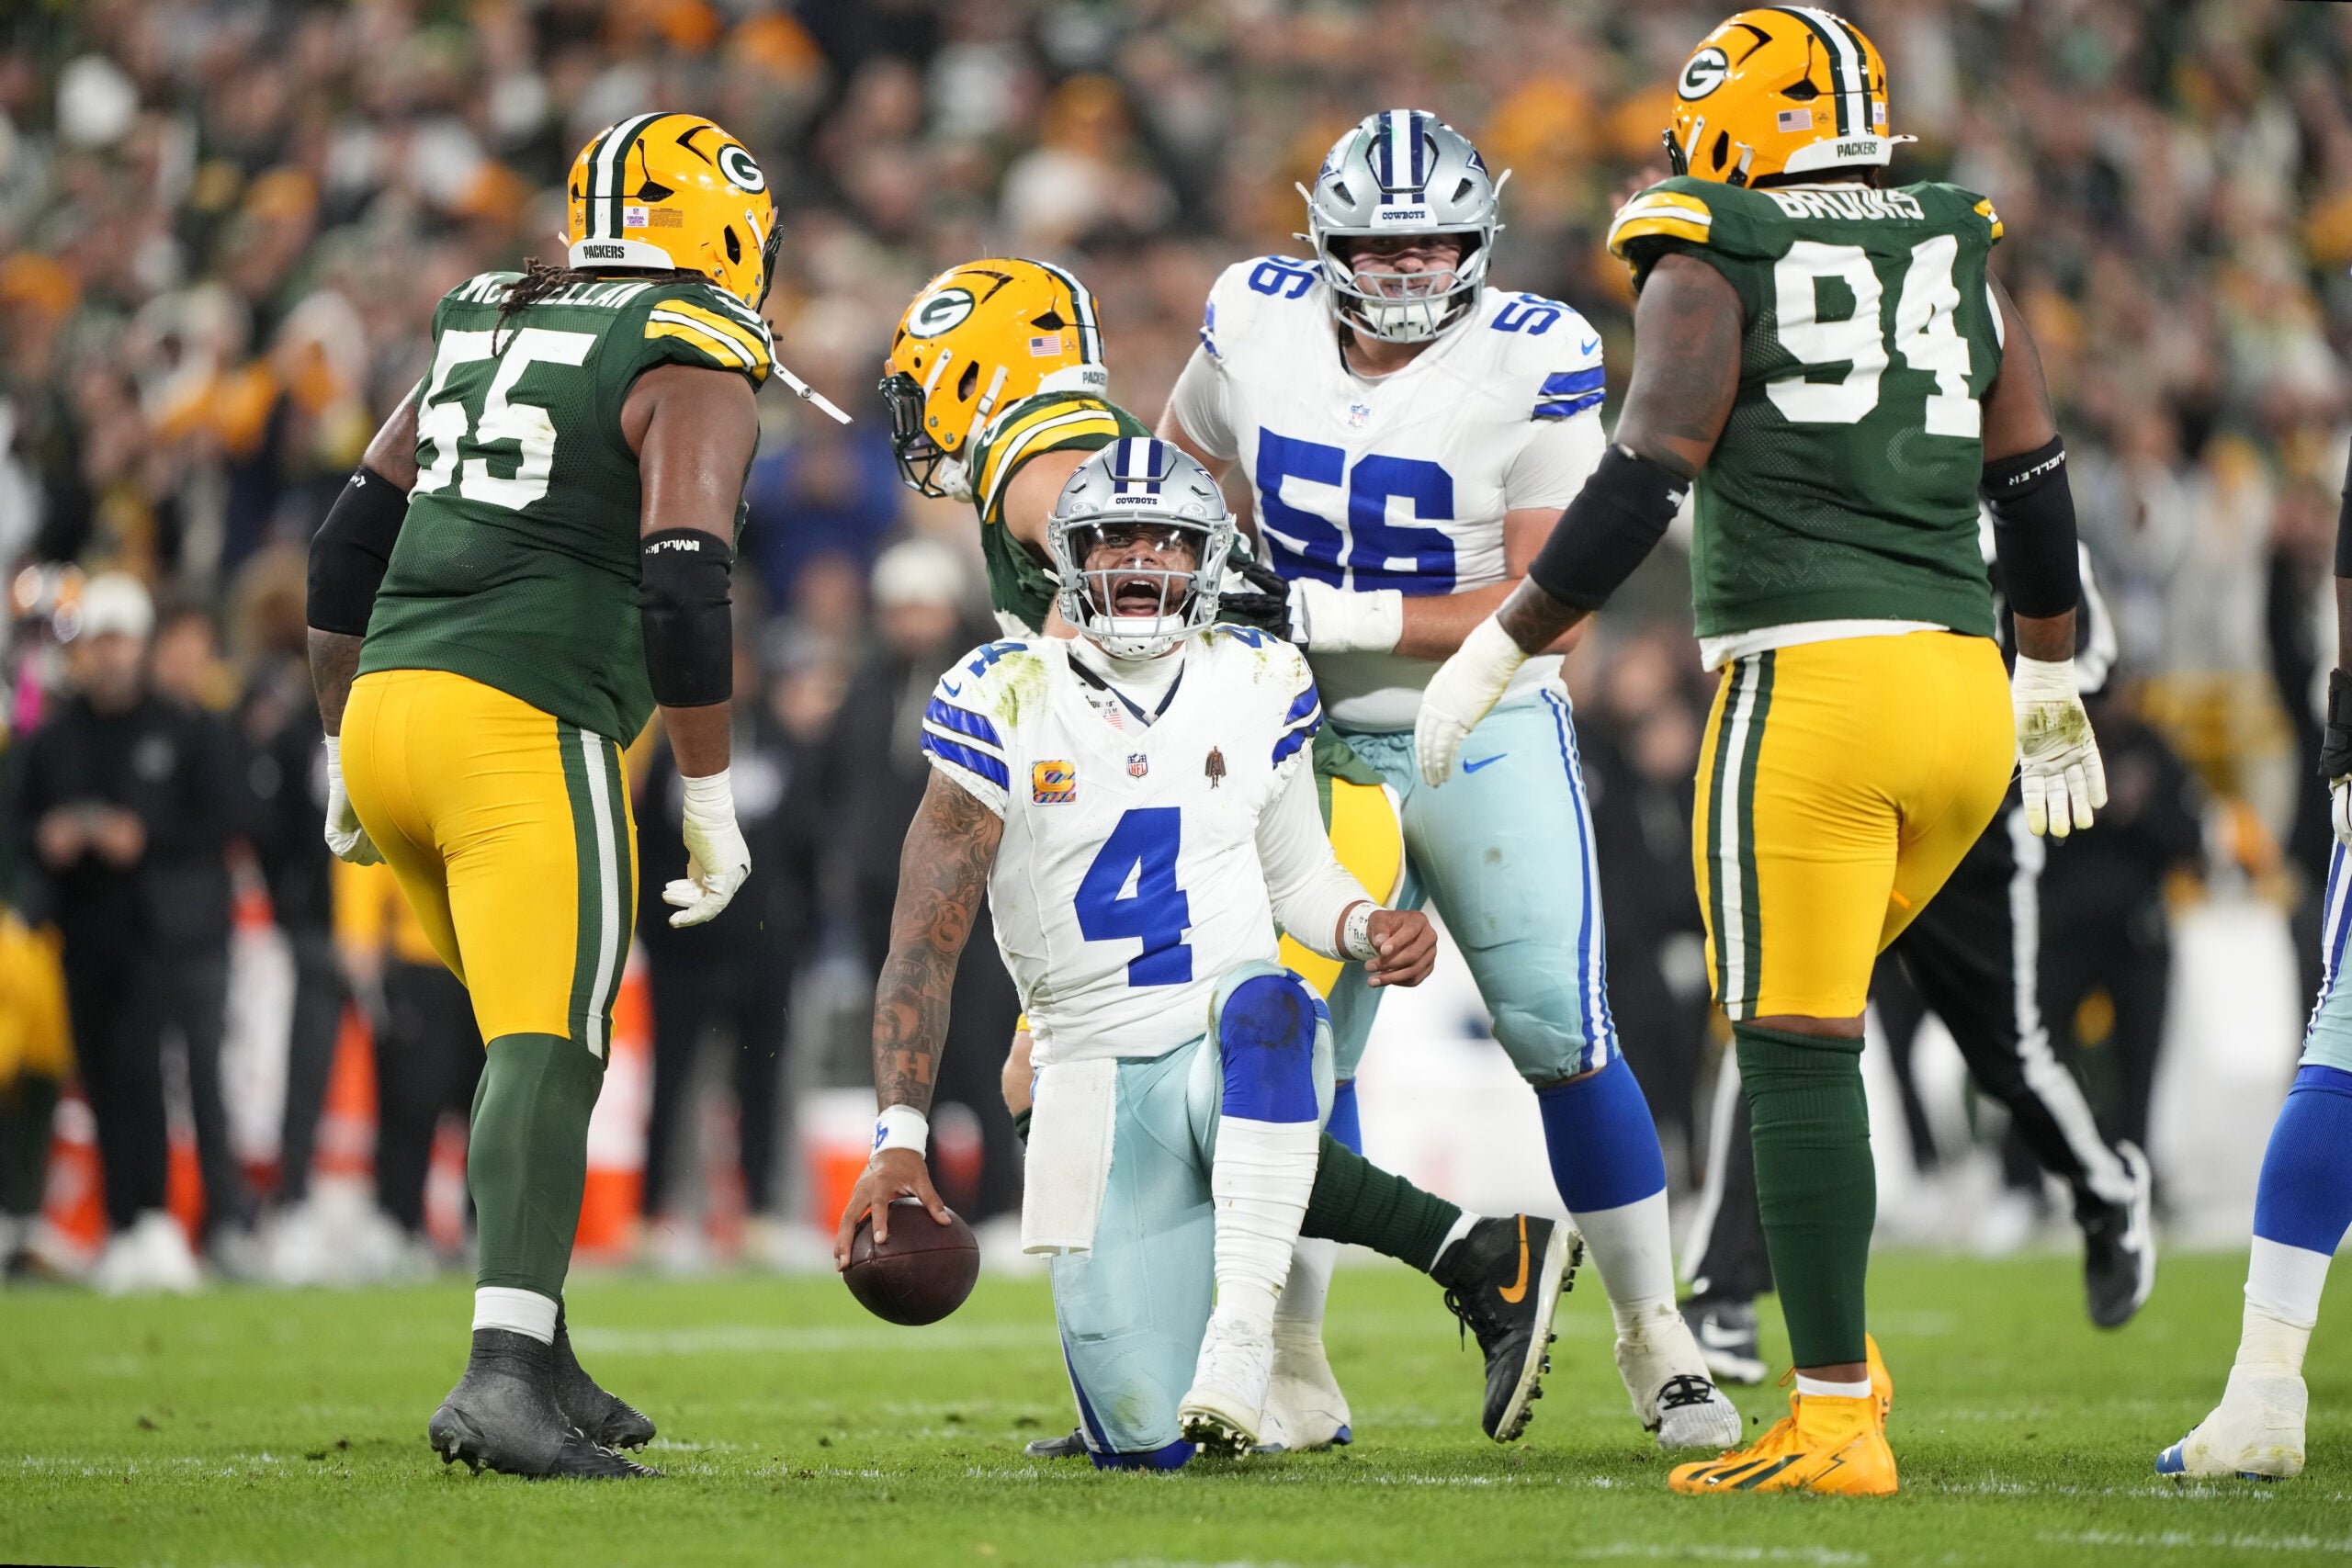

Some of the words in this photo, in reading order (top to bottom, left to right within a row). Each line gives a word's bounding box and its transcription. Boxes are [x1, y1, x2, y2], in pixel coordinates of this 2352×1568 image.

[1837, 141, 1878, 158] PACKERS
[1382, 210, 1426, 220] COWBOYS
[1758, 187, 1926, 220] BROOKS
[582, 244, 625, 259] PACKERS
[908, 288, 974, 336] G
[1766, 234, 1982, 438] 94
[407, 328, 597, 512] 55
[1115, 497, 1158, 505] COWBOYS
[1256, 425, 1456, 598] 56
[1034, 761, 1076, 793] C
[1130, 763, 1146, 775] NFL
[1073, 807, 1193, 987] 4
